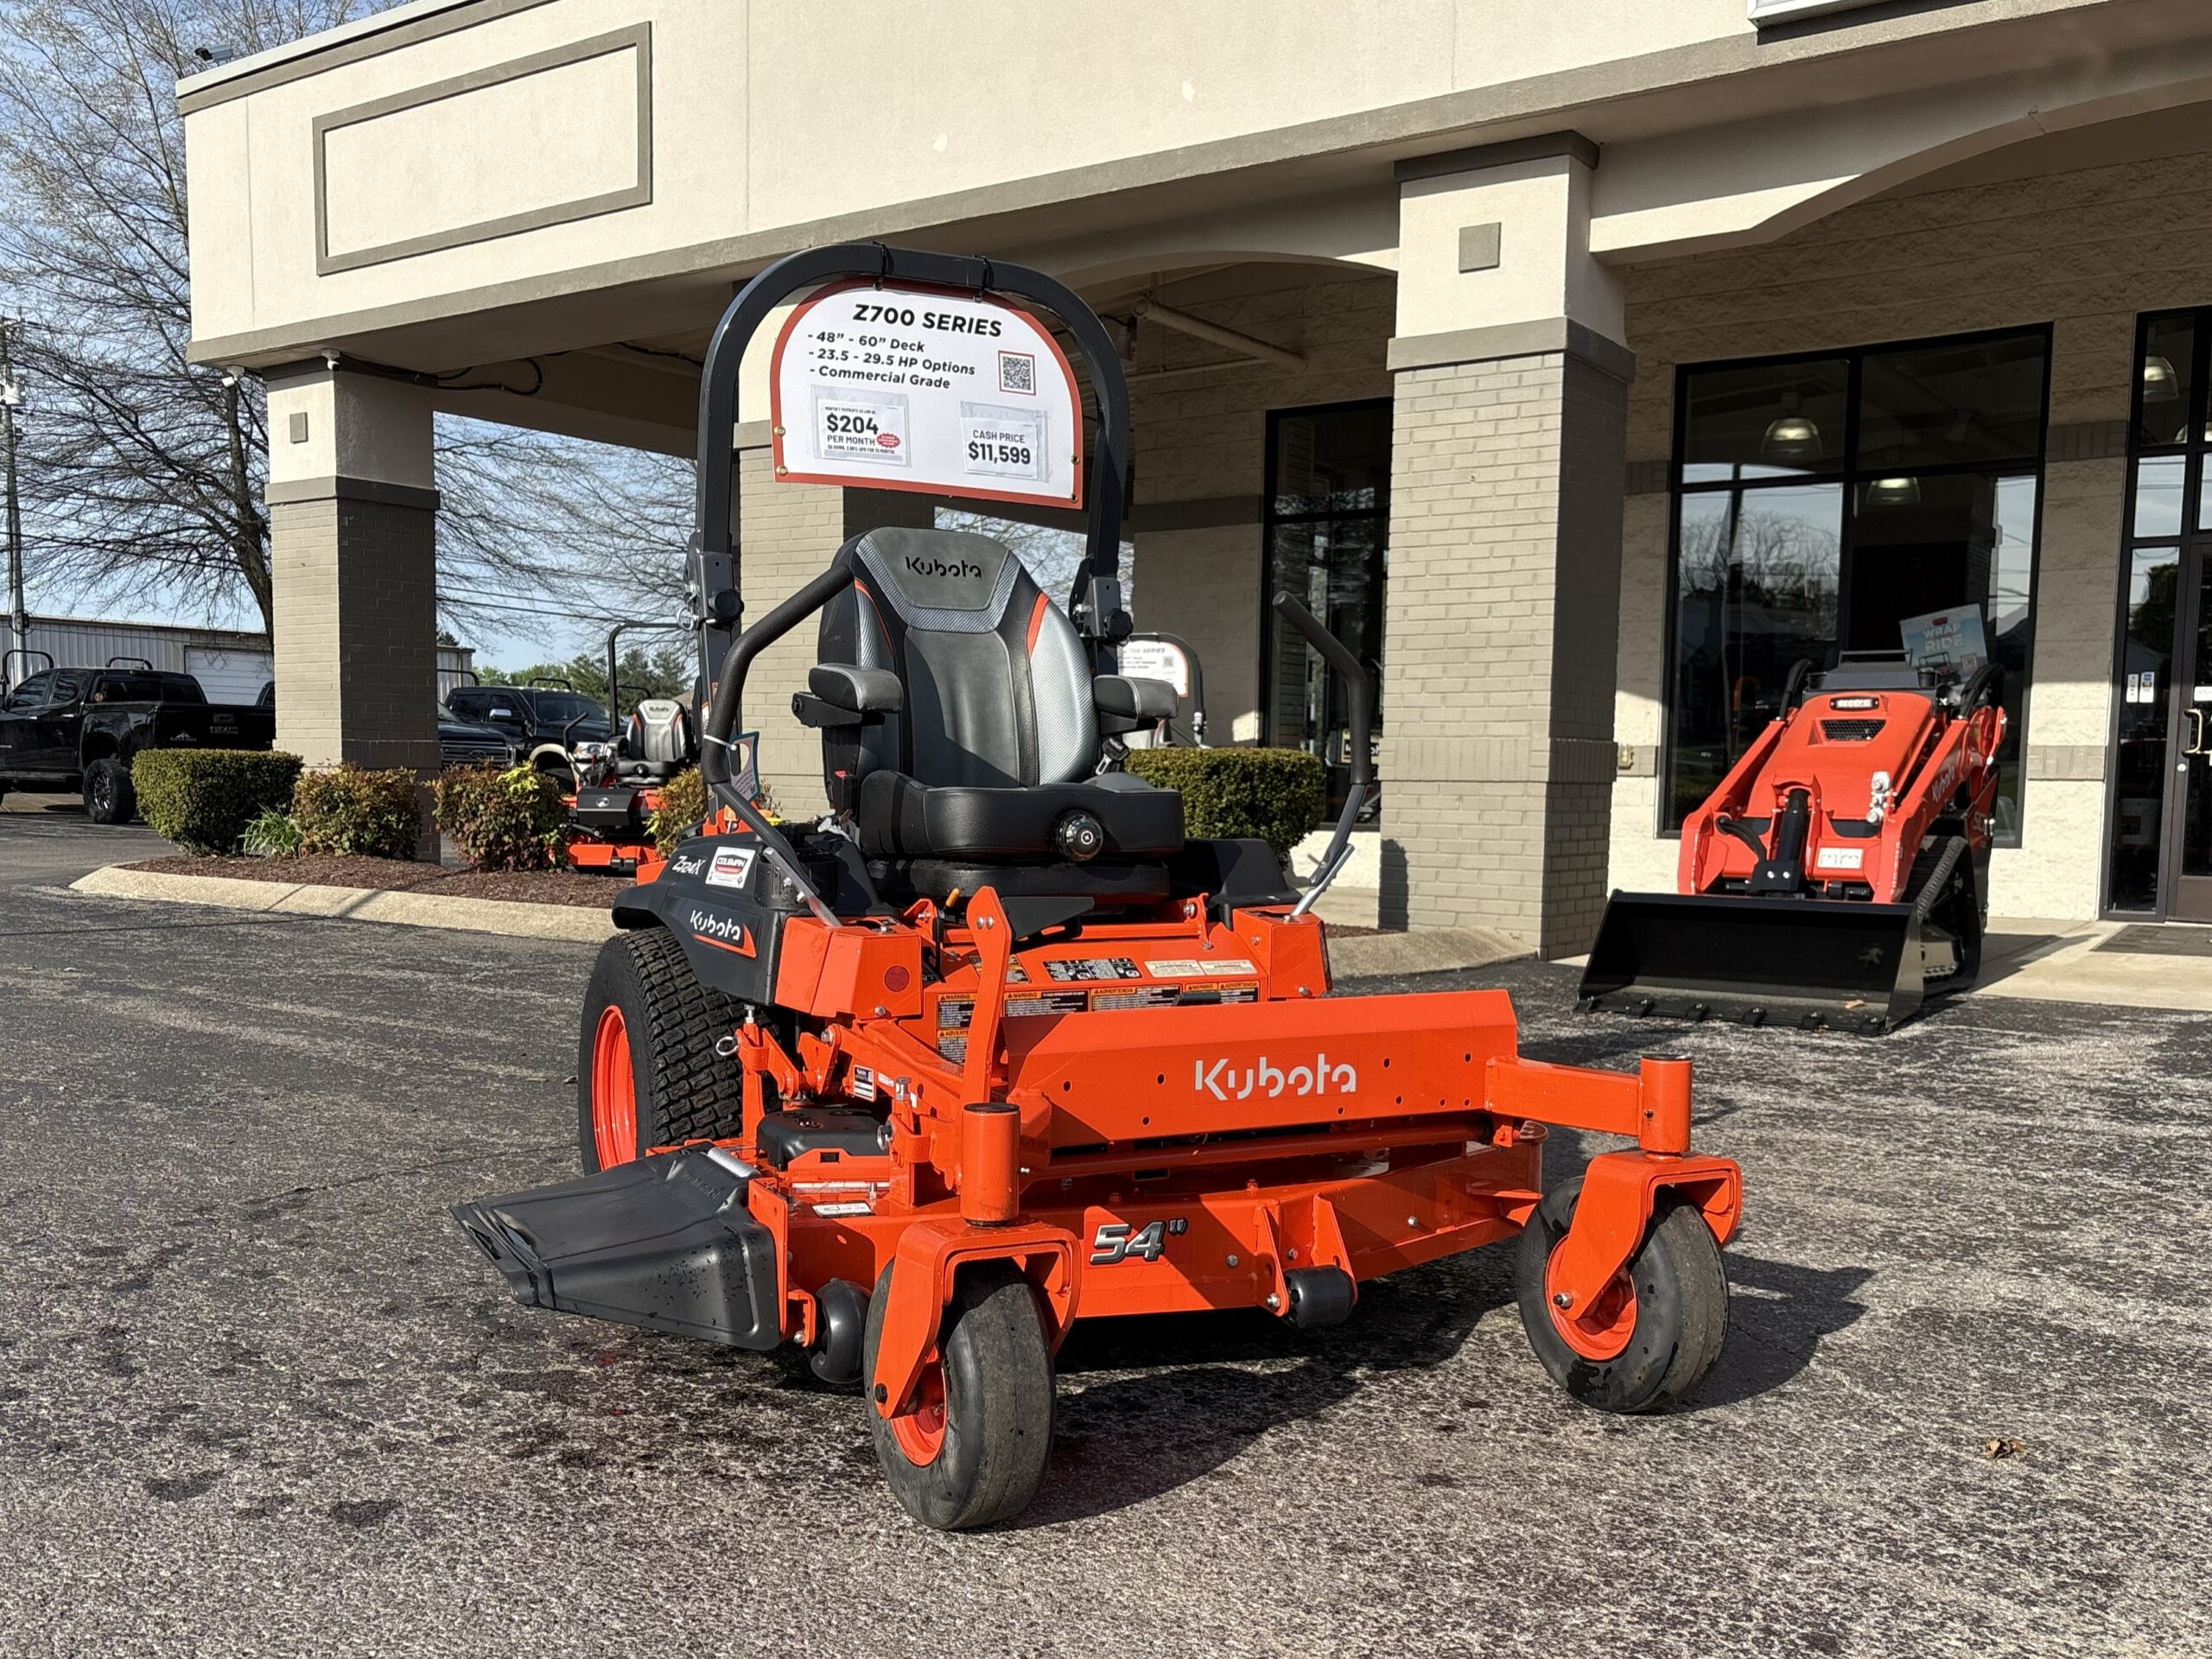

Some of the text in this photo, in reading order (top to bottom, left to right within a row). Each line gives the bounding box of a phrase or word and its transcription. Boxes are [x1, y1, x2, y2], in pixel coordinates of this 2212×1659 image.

[853, 304, 1002, 337] Z700 SERIES
[890, 339, 925, 353] Deck
[817, 348, 849, 361] 23.5
[863, 353, 893, 365] 29.5
[899, 356, 918, 367] HP
[922, 359, 976, 375] Options
[819, 365, 906, 384] Commercial
[910, 374, 950, 389] Grade
[827, 412, 879, 435] $204
[827, 435, 844, 443] PER
[845, 435, 875, 446] MONTH
[973, 429, 1026, 443] CASH PRICE
[968, 440, 1031, 465] $11,599
[905, 556, 982, 578] Kubota
[1923, 623, 1961, 638] WRAP
[1924, 634, 1964, 652] RIDE
[690, 910, 741, 941] Kubota
[1195, 1053, 1357, 1101] Kubota
